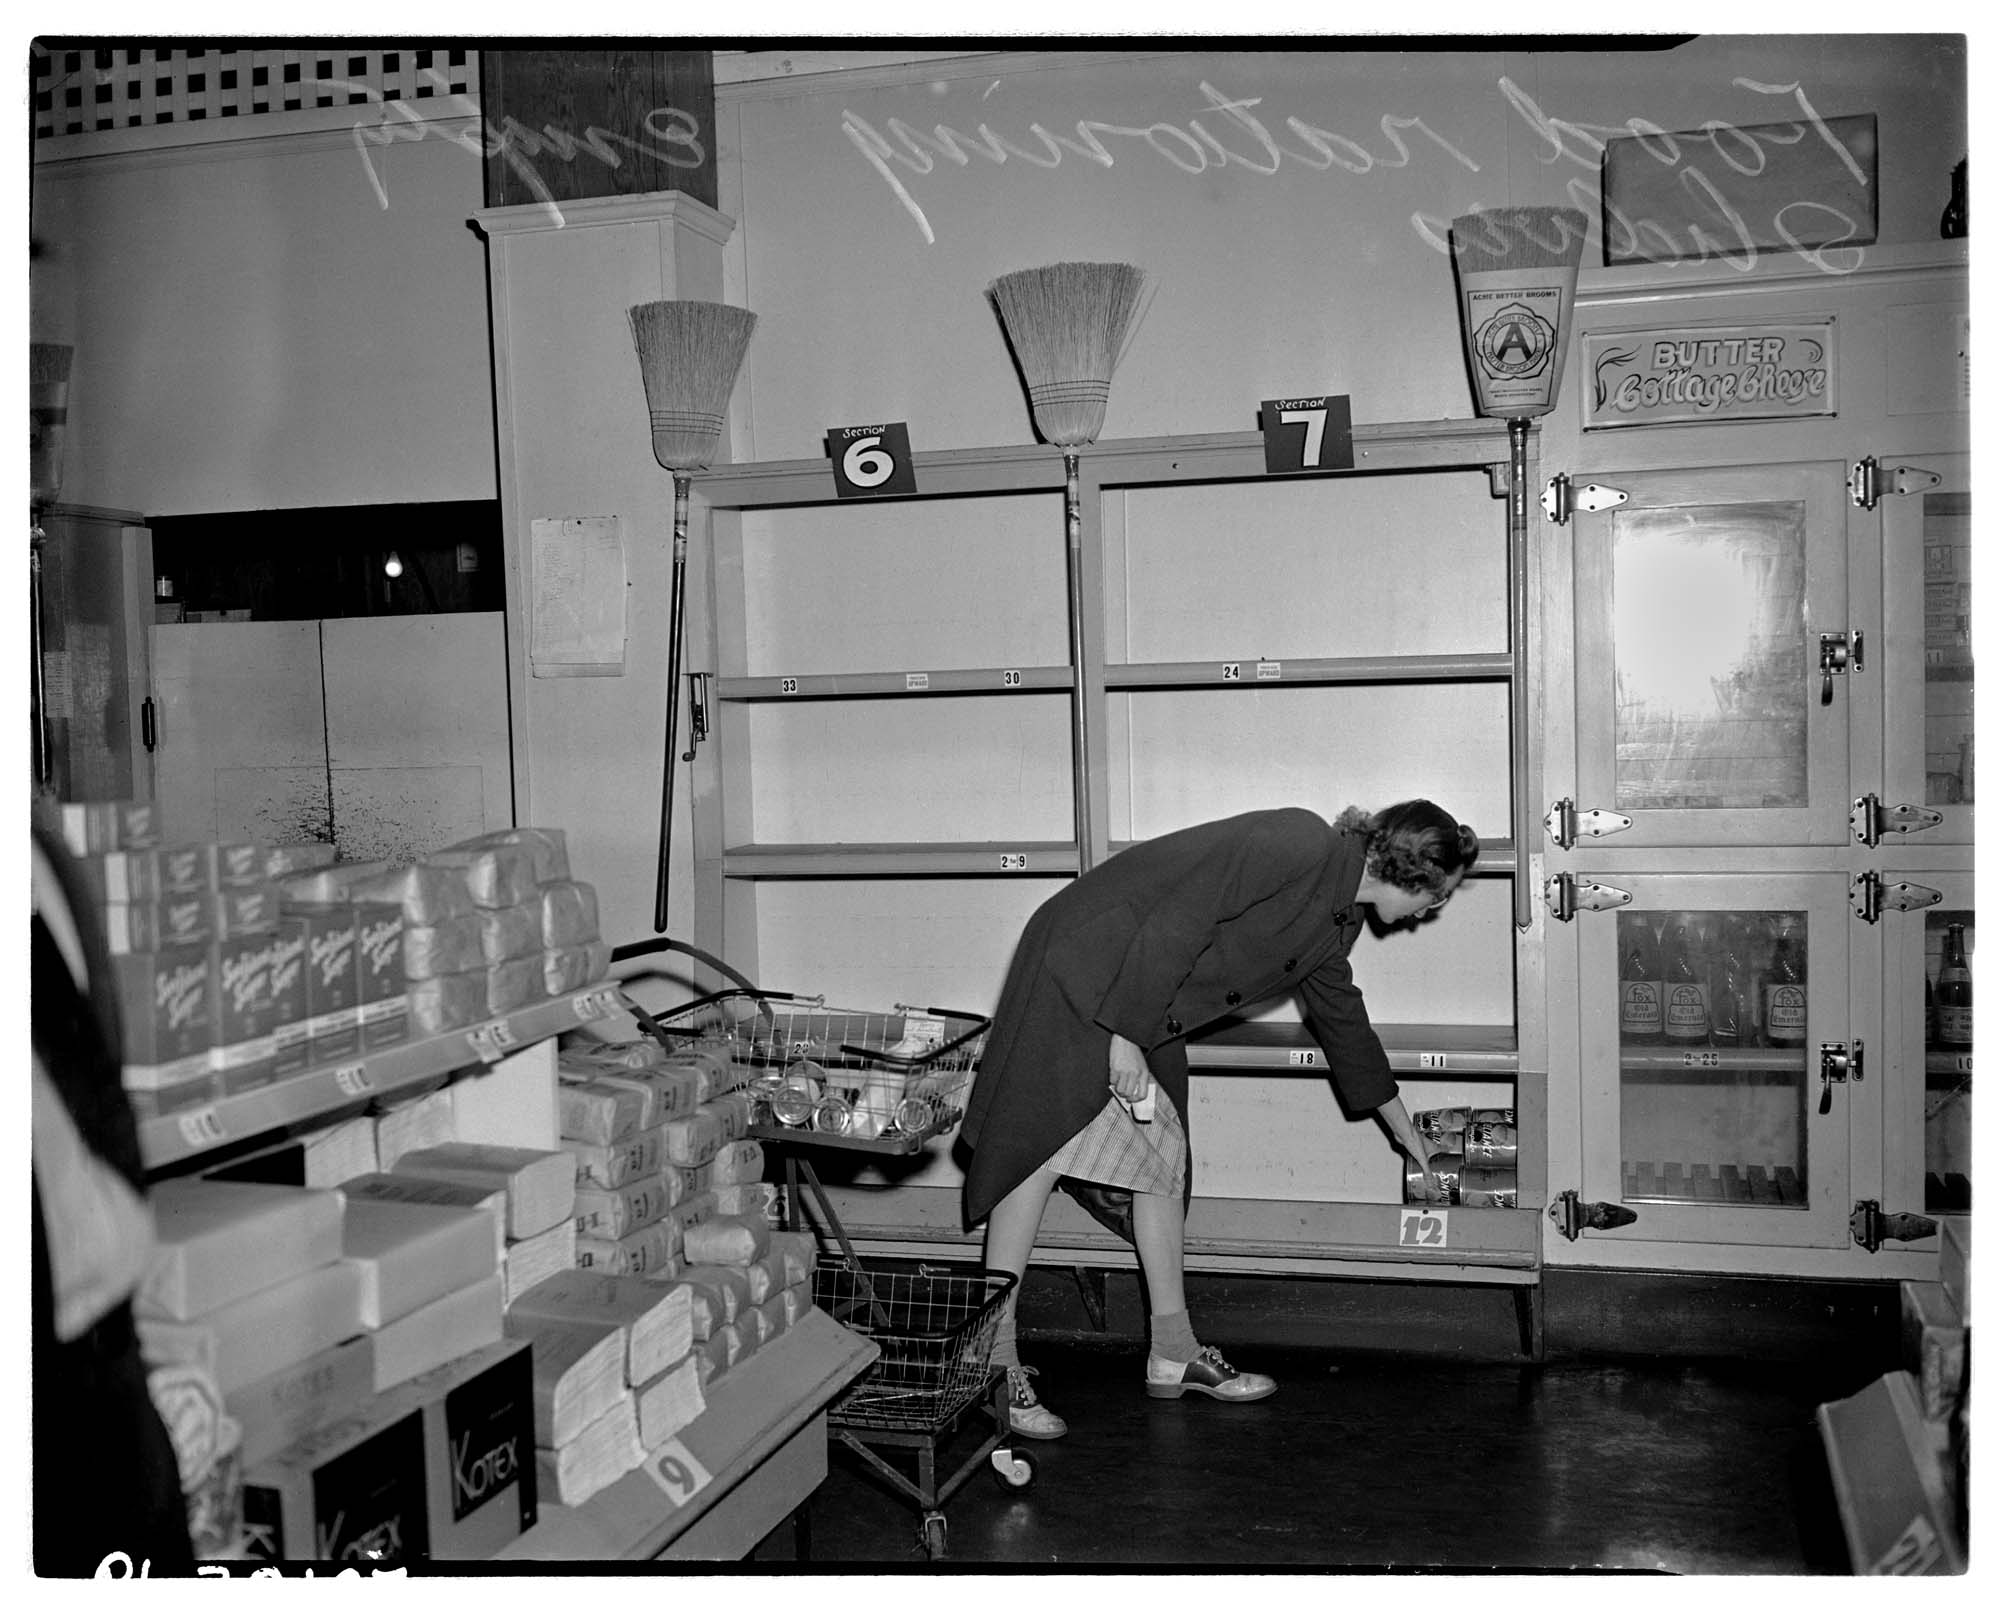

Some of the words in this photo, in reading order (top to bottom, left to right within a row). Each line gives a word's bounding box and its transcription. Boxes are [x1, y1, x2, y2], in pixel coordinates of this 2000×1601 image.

[1526, 291, 1557, 299] BROOMS
[1496, 321, 1533, 361] A
[1653, 336, 1786, 370] BUTTER
[1610, 367, 1737, 414] Cottage
[1735, 362, 1827, 405] Cheese
[1280, 408, 1328, 467] 7
[842, 436, 895, 488] 6
[1005, 671, 1020, 685] 30
[1224, 666, 1239, 679] 24
[783, 680, 797, 692] 33
[1001, 856, 1008, 868] 2
[1019, 855, 1026, 868] 9
[1300, 1052, 1314, 1065] 18
[1431, 1055, 1444, 1067] 11
[1401, 1215, 1443, 1246] 12
[657, 1454, 696, 1497] 9
